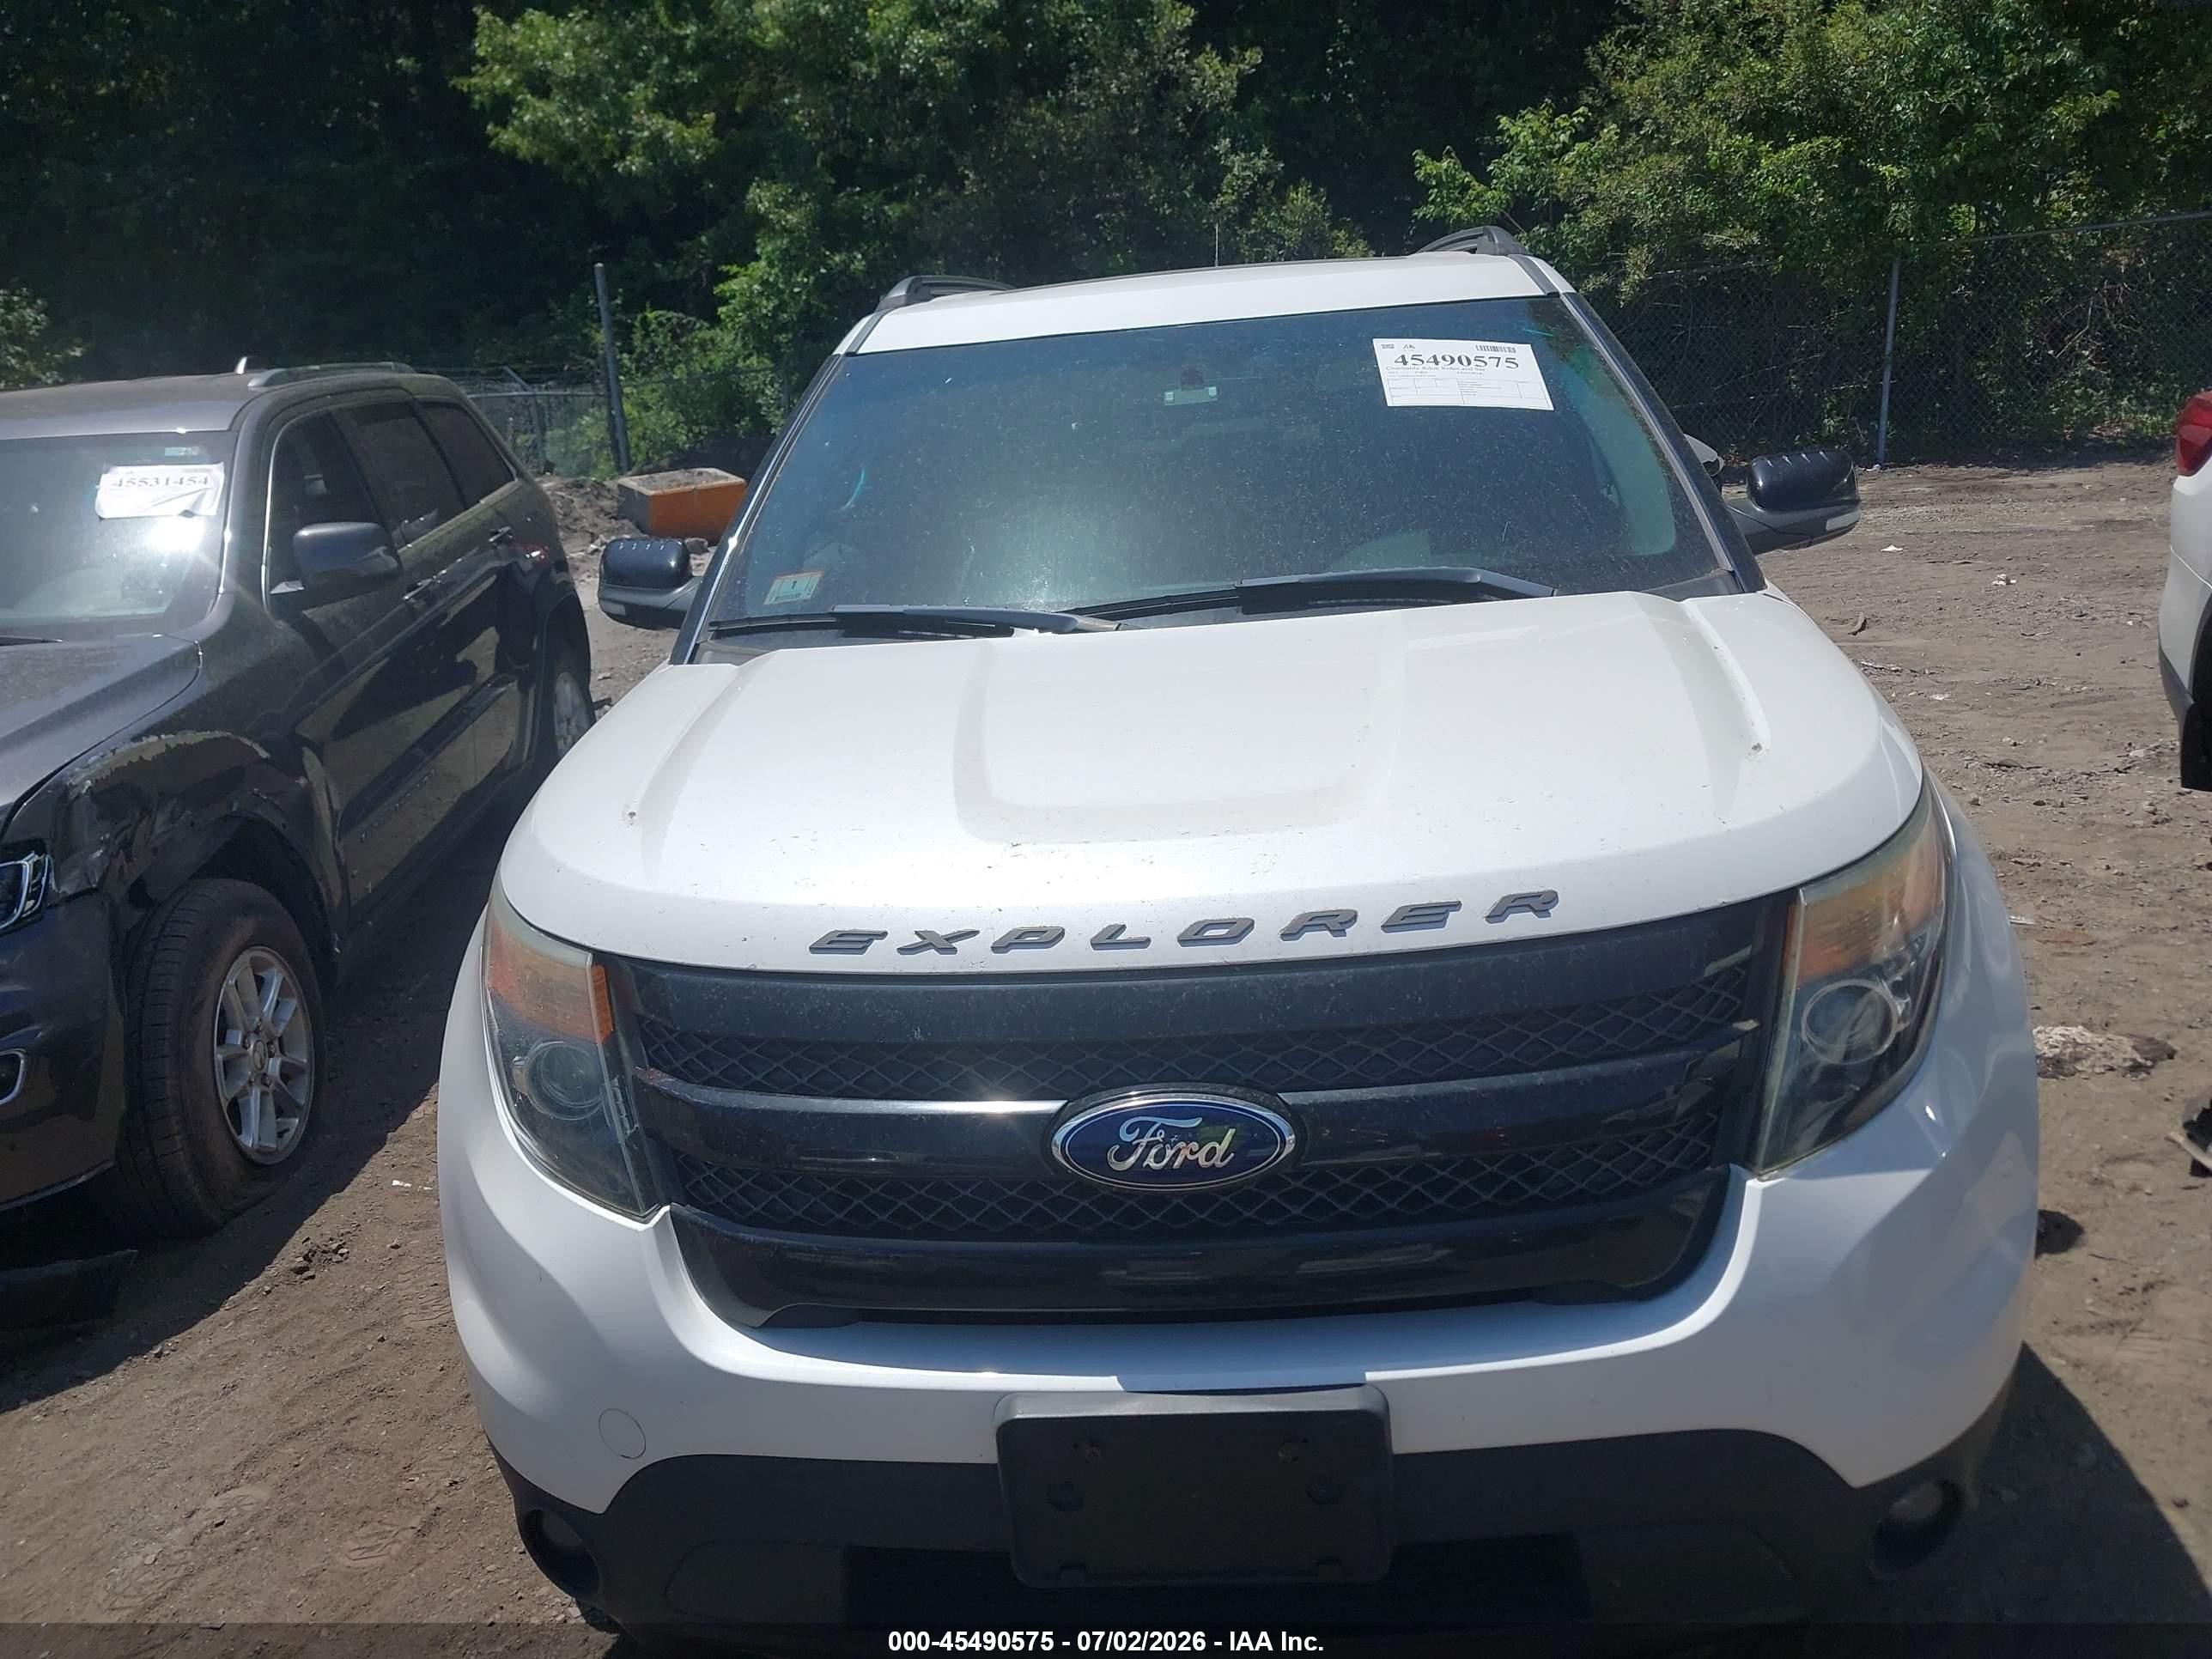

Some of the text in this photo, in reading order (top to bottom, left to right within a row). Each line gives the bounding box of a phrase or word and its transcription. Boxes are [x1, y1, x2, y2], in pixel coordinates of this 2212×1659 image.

[1394, 354, 1520, 369] 45490575
[112, 477, 209, 488] 45531454
[809, 890, 1559, 955] EXPLORER
[1107, 1116, 1236, 1170] Ford
